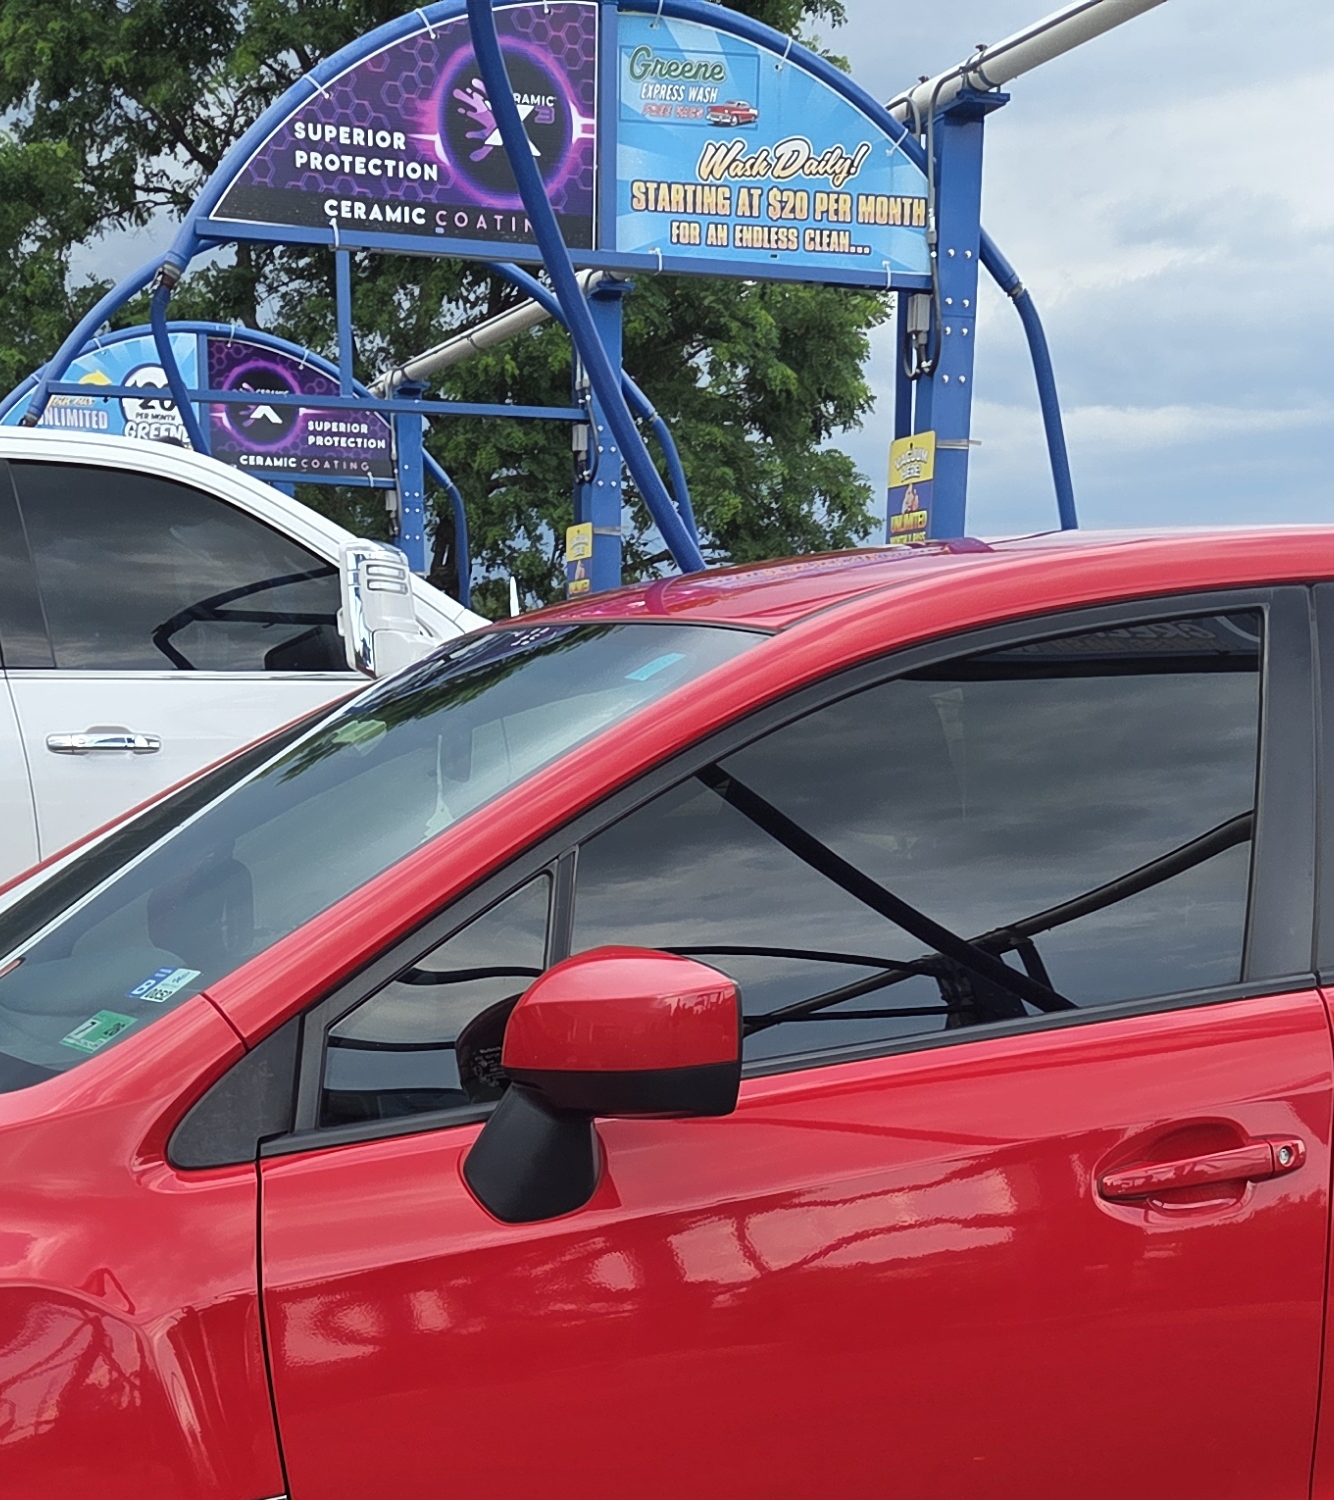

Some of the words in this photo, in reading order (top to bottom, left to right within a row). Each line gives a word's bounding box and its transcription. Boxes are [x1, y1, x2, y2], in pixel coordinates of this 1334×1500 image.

[629, 46, 725, 82] Greene
[641, 83, 686, 101] EXPRESS
[688, 87, 718, 102] WASH
[294, 122, 406, 150] SUPERIOR
[295, 150, 438, 182] PROTECTION
[699, 140, 771, 181] Wash
[772, 138, 870, 188] Daily!
[324, 199, 426, 225] CERAMIC
[435, 210, 533, 233] COATIN
[631, 181, 731, 216] STARTING
[736, 187, 762, 217] AT
[768, 187, 808, 220] $20
[815, 192, 851, 222] PER
[857, 195, 926, 227] MONTH
[671, 221, 700, 244] FOR
[707, 224, 728, 246] AN
[734, 225, 798, 250] ENDLESS
[307, 420, 368, 434] SUPERIOR
[307, 435, 386, 449] PROTECTION
[239, 455, 297, 467] CERAMIC
[301, 459, 369, 471] COATING
